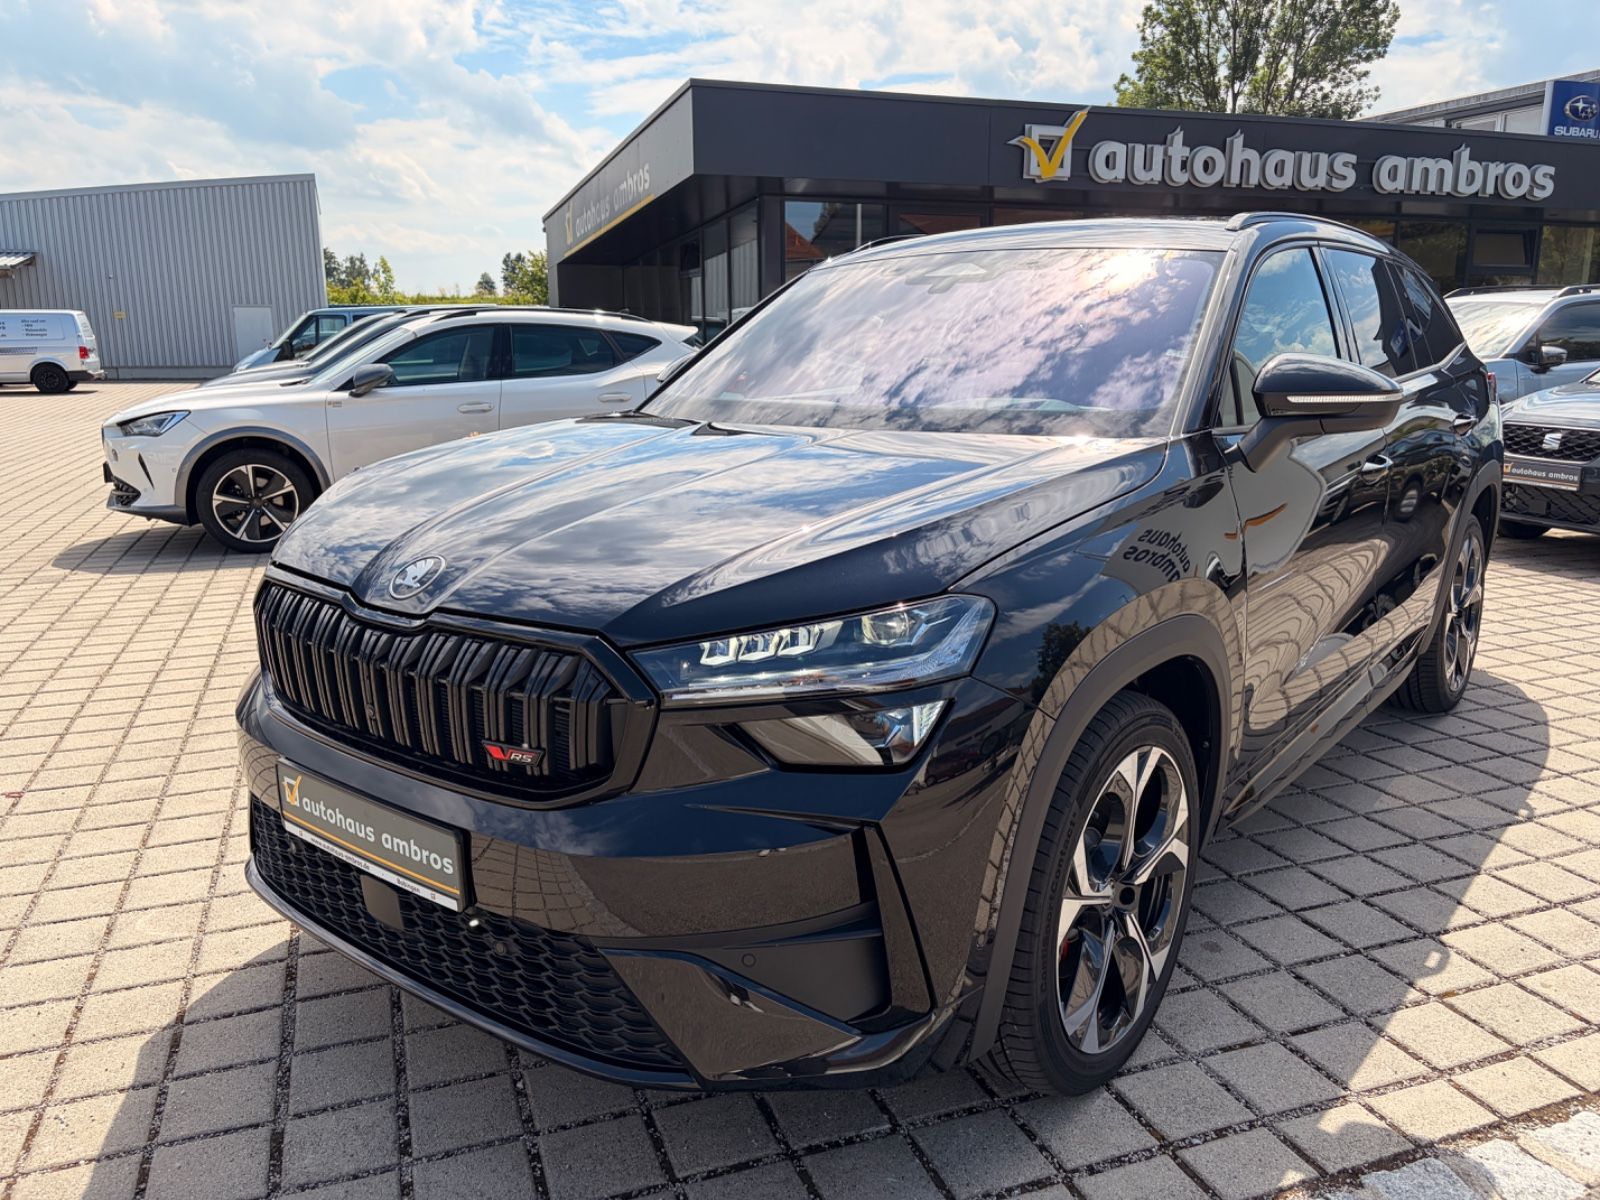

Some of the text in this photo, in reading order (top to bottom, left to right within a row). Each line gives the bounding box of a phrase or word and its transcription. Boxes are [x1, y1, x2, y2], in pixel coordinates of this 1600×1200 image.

[1553, 125, 1600, 139] SUBARU
[613, 163, 650, 211] ambros
[1089, 126, 1556, 200] autohaus ambros
[1511, 466, 1578, 481] autohaus ambros
[303, 797, 454, 874] autohaus ambros
